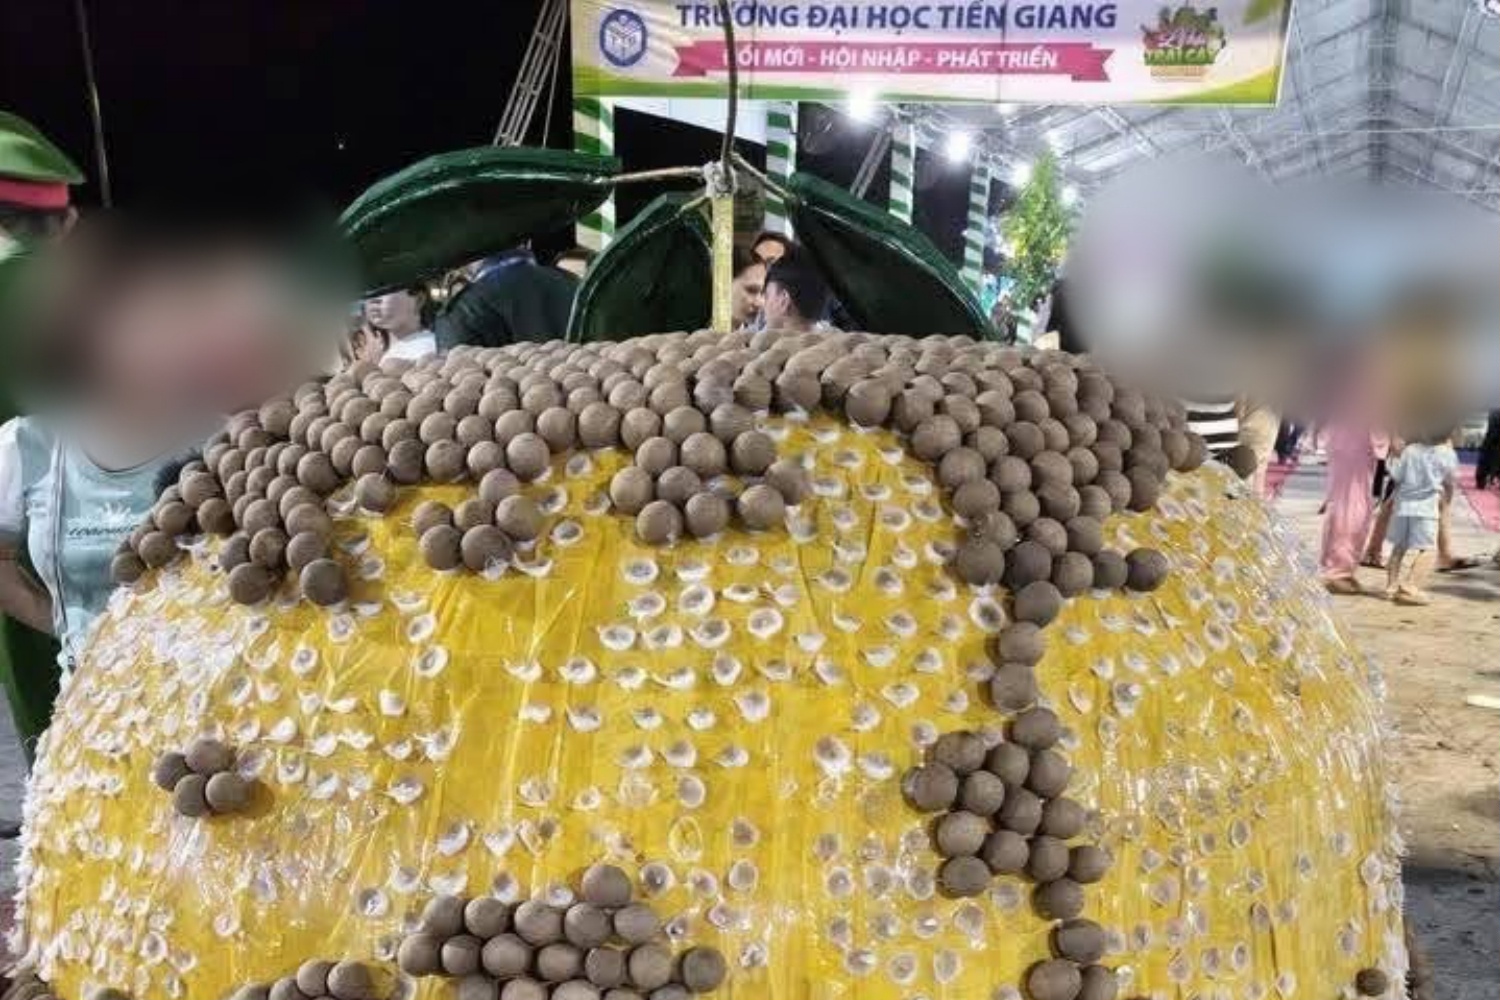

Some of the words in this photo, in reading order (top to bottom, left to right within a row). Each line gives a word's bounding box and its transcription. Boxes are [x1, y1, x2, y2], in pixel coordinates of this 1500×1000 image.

[806, 5, 858, 35] ĐẠI
[866, 5, 931, 35] HỌC
[1014, 4, 1117, 28] GIANG
[764, 46, 804, 66] MỚI
[937, 46, 992, 67] PHÁT
